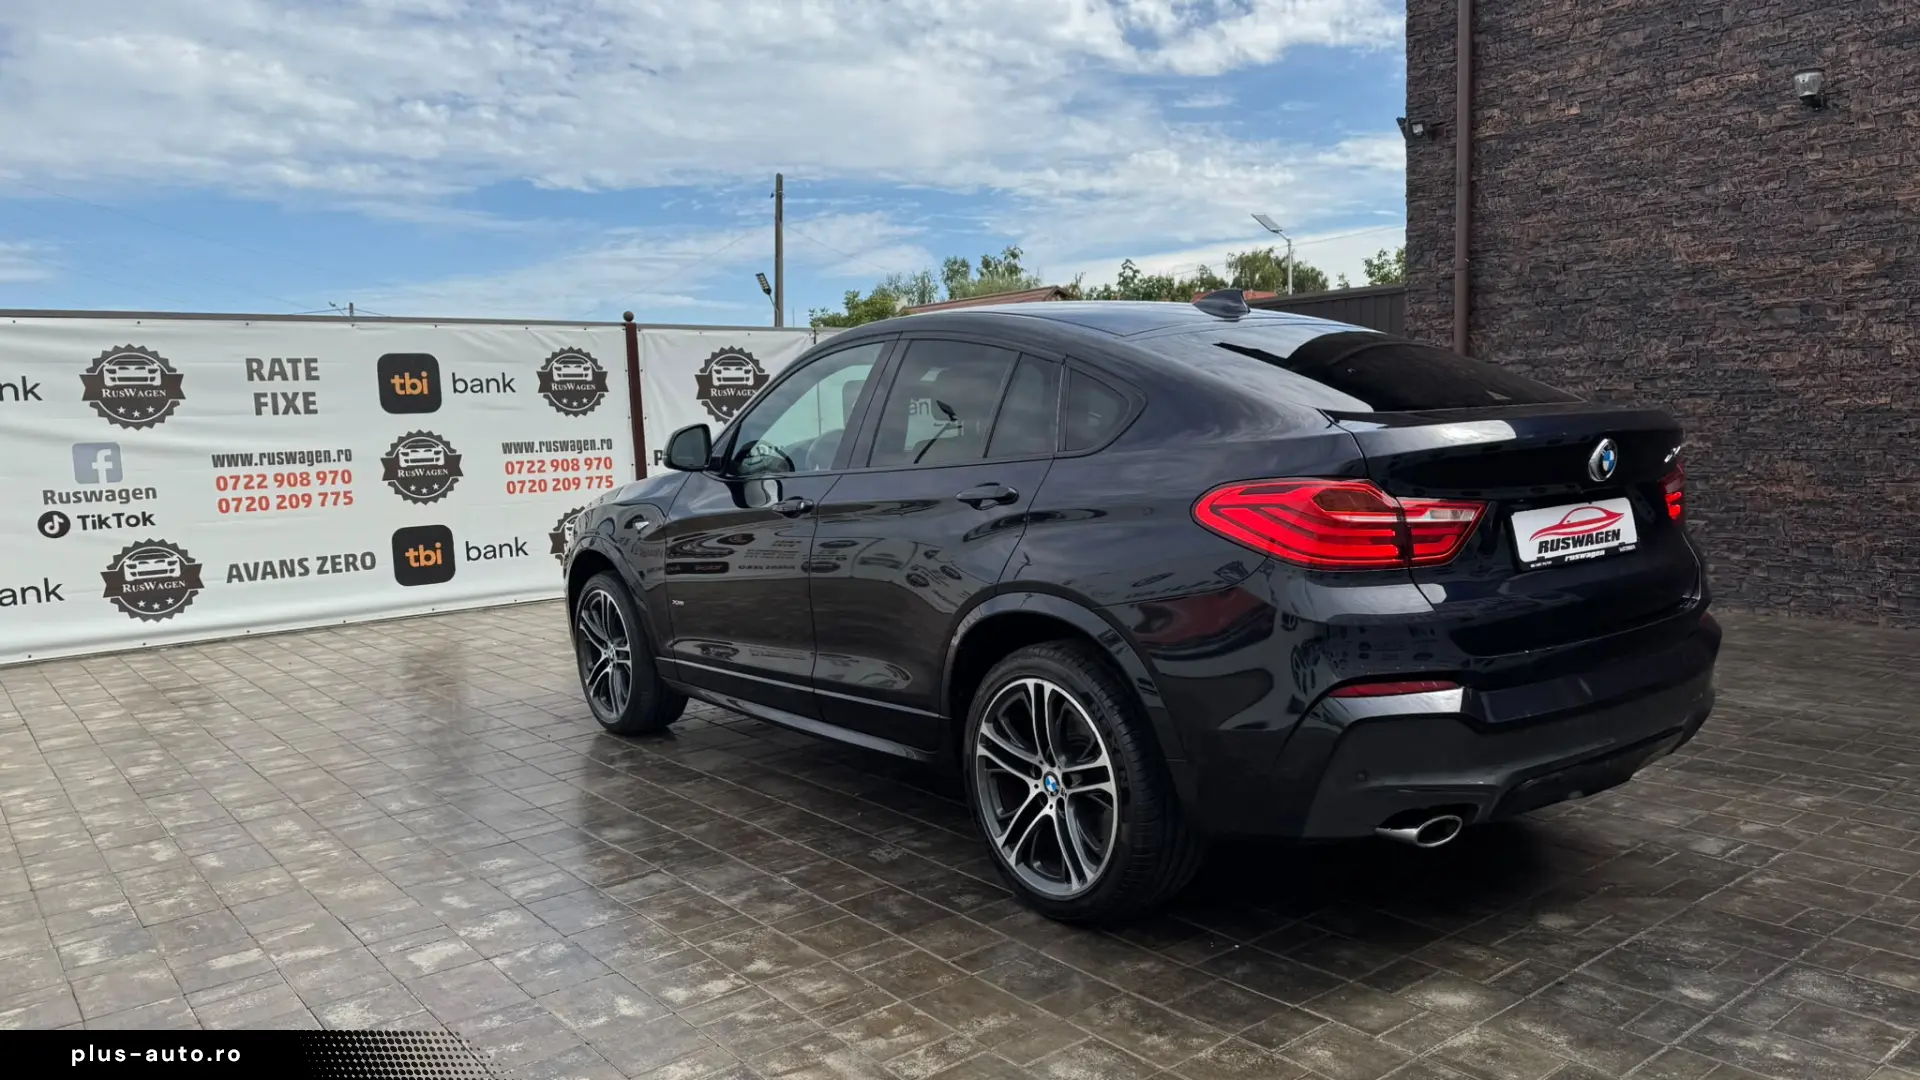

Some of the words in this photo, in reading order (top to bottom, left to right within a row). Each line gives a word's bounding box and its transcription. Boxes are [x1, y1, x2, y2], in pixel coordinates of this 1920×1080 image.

[246, 357, 320, 381] RATE
[391, 371, 429, 395] tbi
[451, 372, 516, 394] bank
[253, 391, 319, 416] FIXE
[501, 438, 613, 454] www.ruswagen.ro
[211, 448, 353, 468] www.ruswagen.ro
[505, 459, 546, 475] 0722
[550, 458, 580, 472] 908
[584, 456, 613, 471] 970
[215, 473, 268, 491] 0722
[273, 471, 311, 488] 908
[315, 469, 353, 486] 970
[506, 478, 548, 494] 0720
[552, 477, 581, 492] 209
[585, 475, 614, 490] 775
[42, 486, 157, 505] Ruswagen
[217, 495, 270, 513] 0720
[276, 492, 312, 510] 209
[317, 490, 354, 507] 775
[76, 511, 156, 531] TikTok
[405, 541, 443, 568] tbi
[465, 536, 529, 562] bank
[1538, 528, 1621, 554] RUSWAGEN
[1564, 549, 1606, 562] ruswagen
[226, 557, 310, 584] AVANS
[316, 551, 376, 575] ZERO
